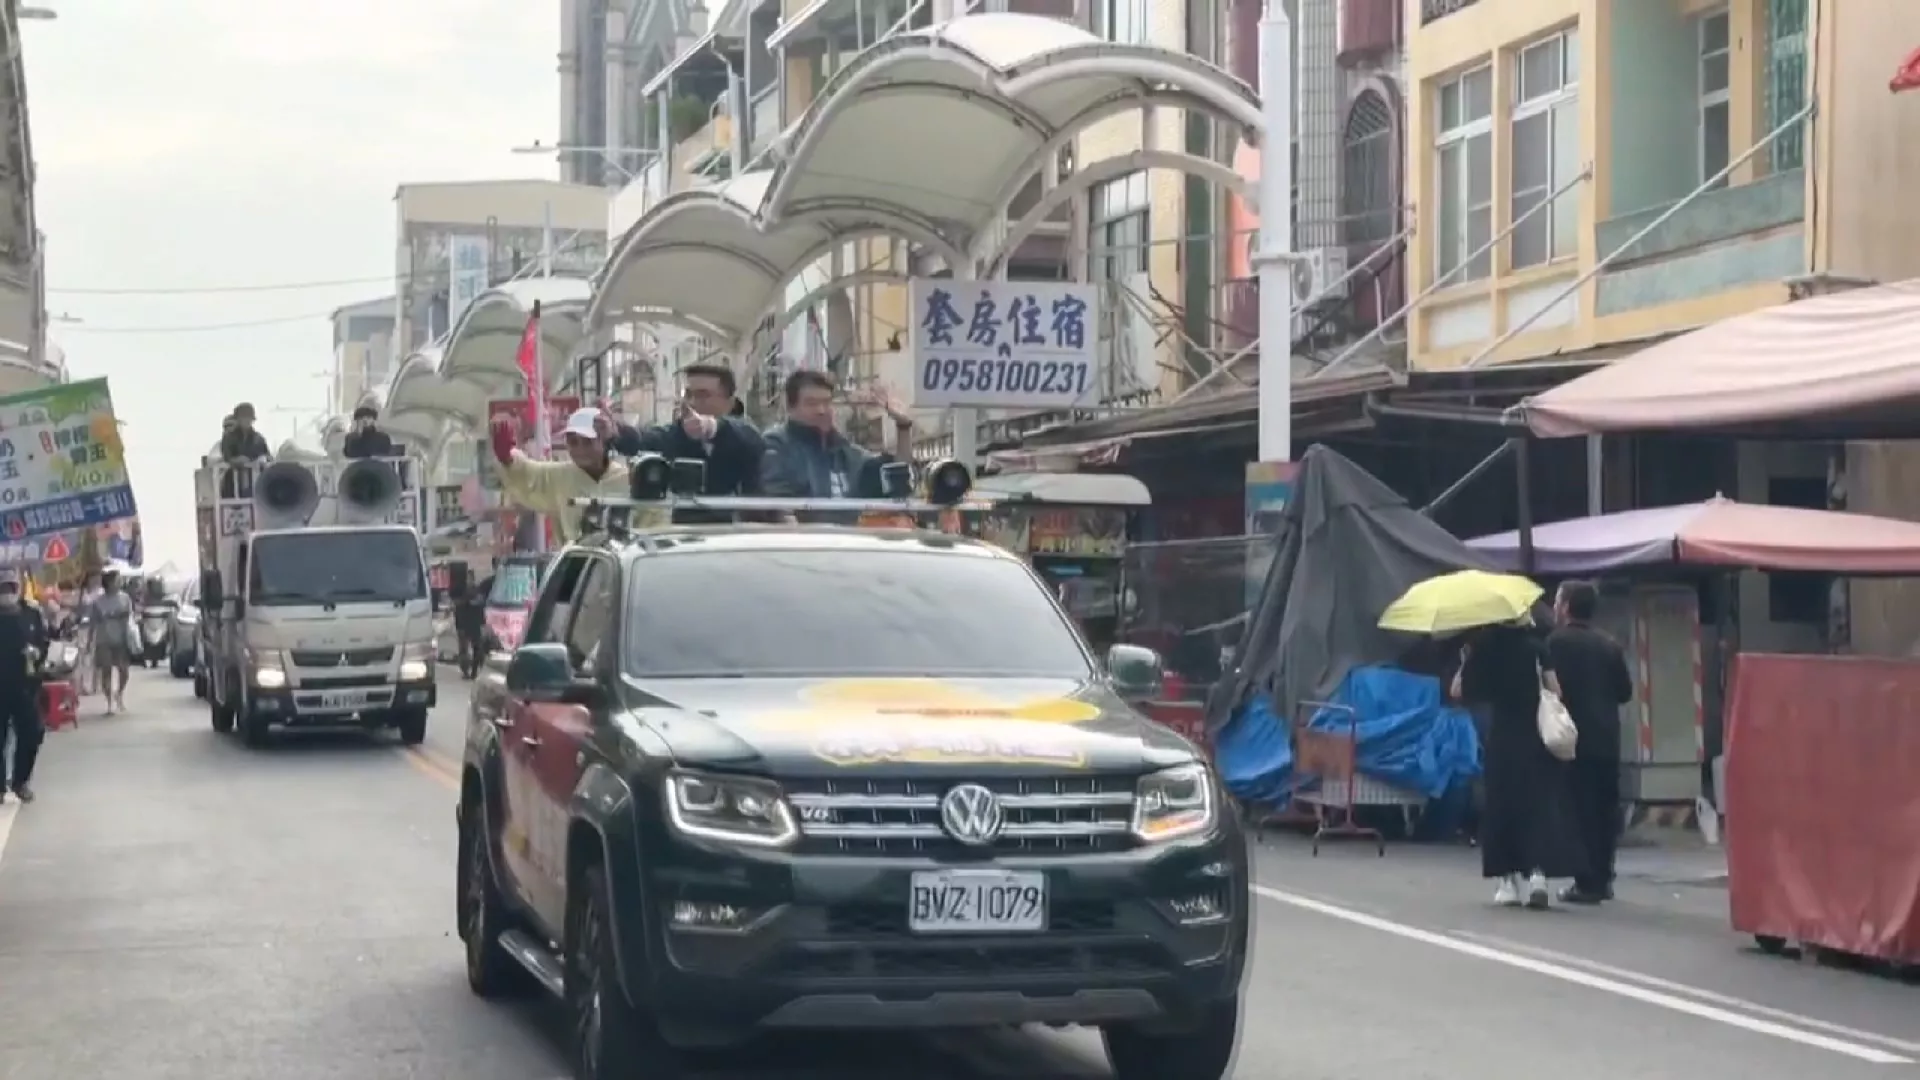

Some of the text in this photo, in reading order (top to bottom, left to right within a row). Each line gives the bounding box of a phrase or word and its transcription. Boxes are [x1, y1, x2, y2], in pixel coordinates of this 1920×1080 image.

[922, 287, 1087, 349] 套房住宿
[923, 358, 1087, 394] 0958100231
